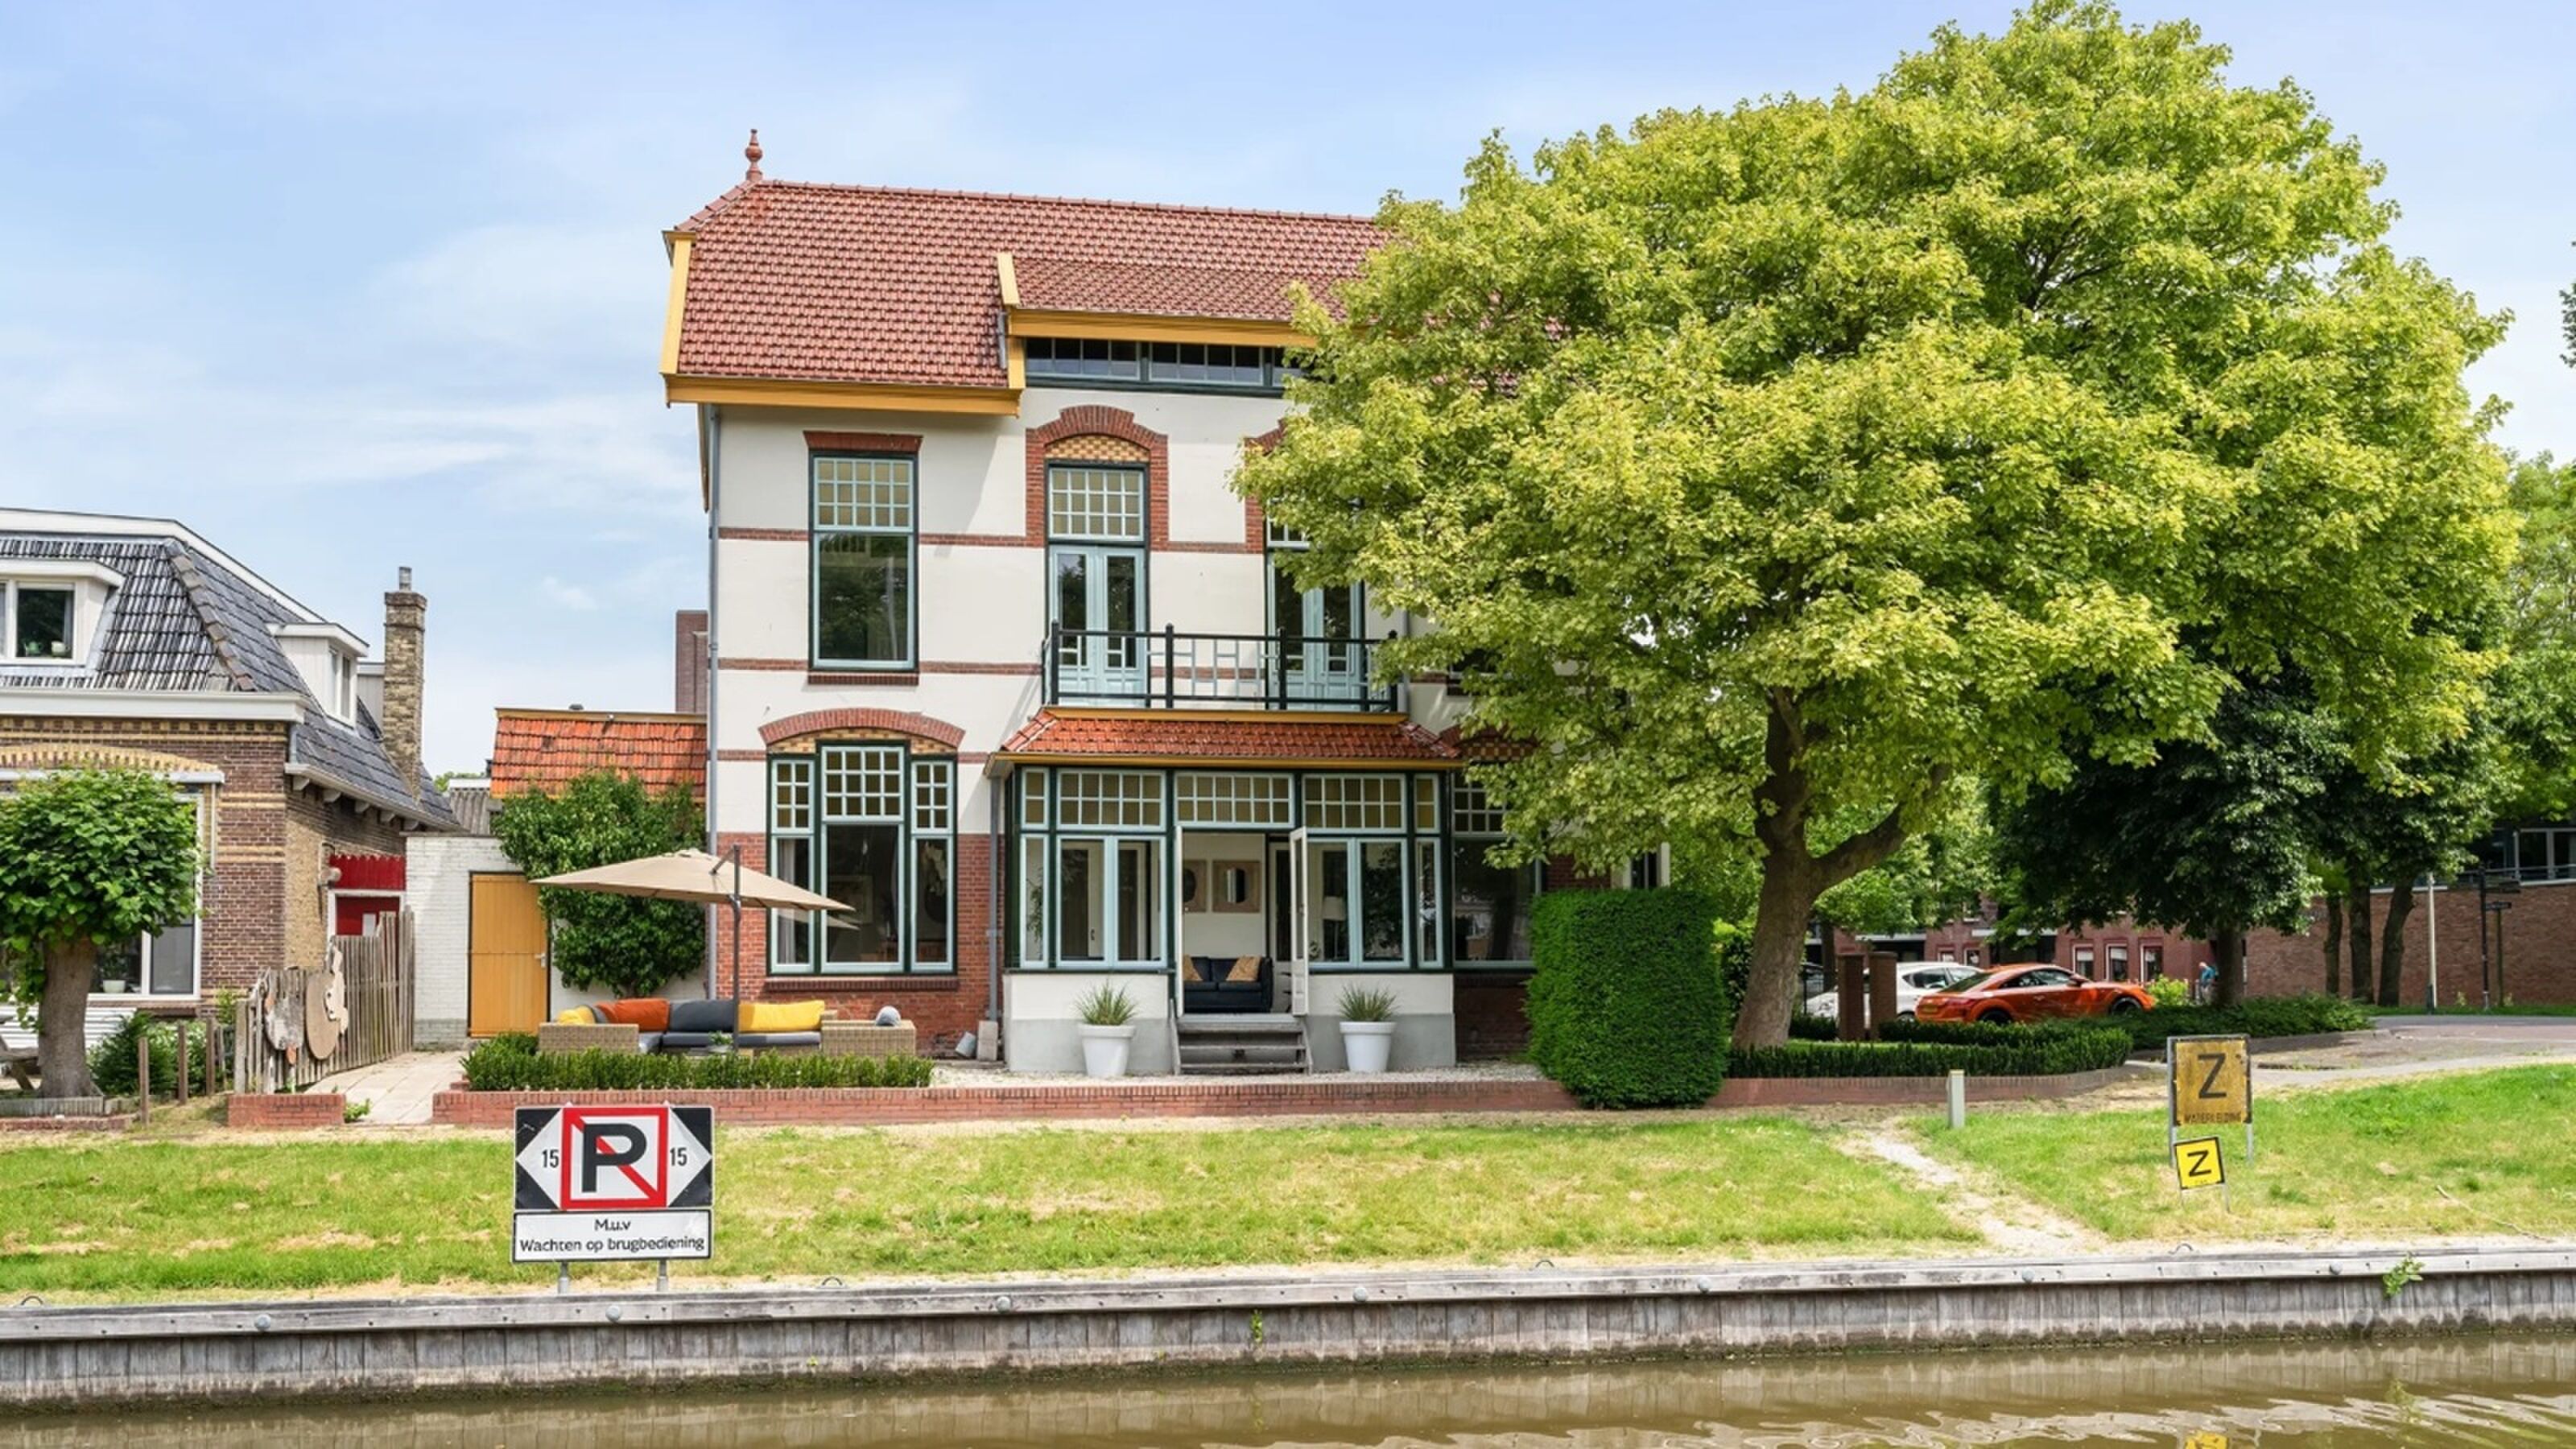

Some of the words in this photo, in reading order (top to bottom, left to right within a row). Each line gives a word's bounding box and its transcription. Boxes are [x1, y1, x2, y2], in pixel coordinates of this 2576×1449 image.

[2198, 1053, 2227, 1099] Z
[543, 1150, 559, 1167] 15
[582, 1123, 647, 1192] P
[670, 1147, 687, 1166] 15
[2186, 1150, 2211, 1177] Z
[519, 1238, 581, 1252] Wachten
[586, 1240, 602, 1253] op
[608, 1236, 704, 1252] brugbediening
